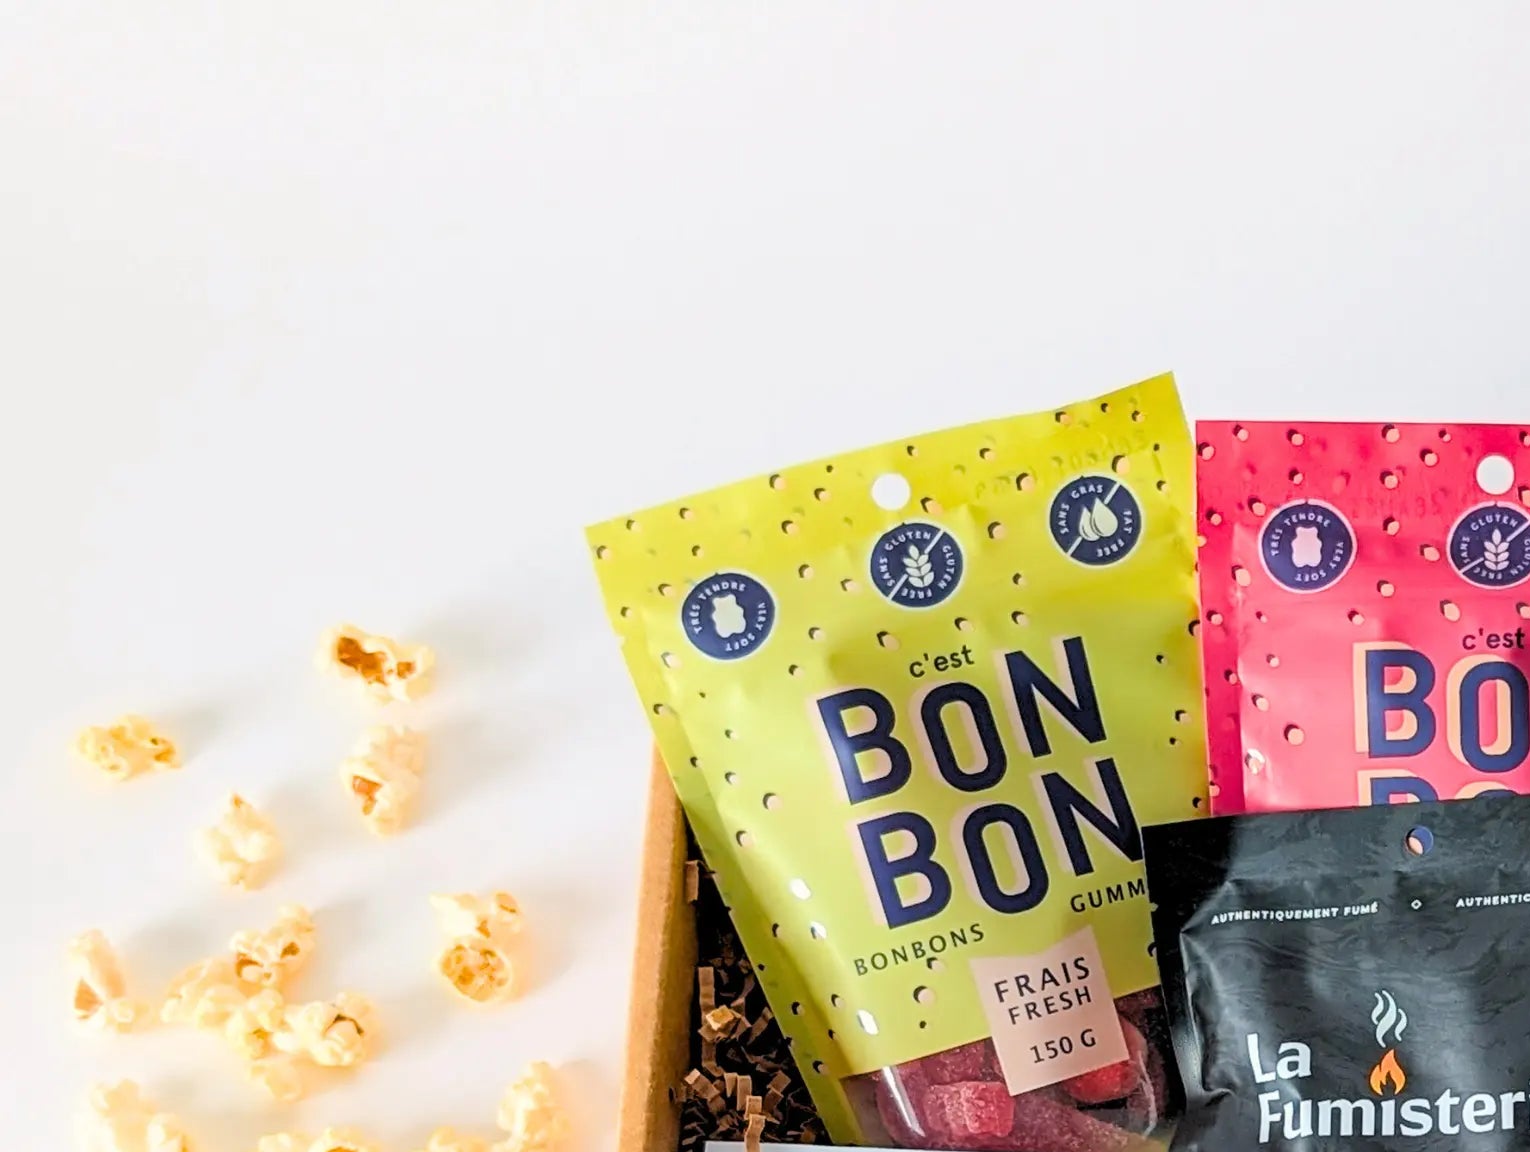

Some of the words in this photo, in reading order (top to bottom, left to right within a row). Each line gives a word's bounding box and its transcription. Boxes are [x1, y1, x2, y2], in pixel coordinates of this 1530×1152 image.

[1058, 503, 1070, 534] SANS
[1071, 484, 1103, 499] GRAS
[1284, 512, 1331, 528] TENDRE
[1470, 514, 1519, 531] GLUTEN
[884, 531, 931, 551] GLUTEN
[879, 557, 896, 587] SANS
[937, 545, 956, 590] GLUTEN
[698, 581, 746, 600] TENDRE
[1460, 627, 1526, 650] c'est
[908, 644, 976, 679] c'est
[813, 636, 1108, 806] BON
[854, 757, 1144, 929] BON
[854, 923, 984, 976] BONBONS
[1070, 878, 1146, 913] GUMM
[1210, 907, 1339, 926] AUTHENTIQUEMENT
[1343, 901, 1380, 917] FUMÉ
[994, 957, 1090, 1003] FRAIS
[1008, 985, 1092, 1025] FRESH
[1029, 1035, 1073, 1064] 150
[1080, 1029, 1097, 1048] G
[1246, 1033, 1312, 1085] La
